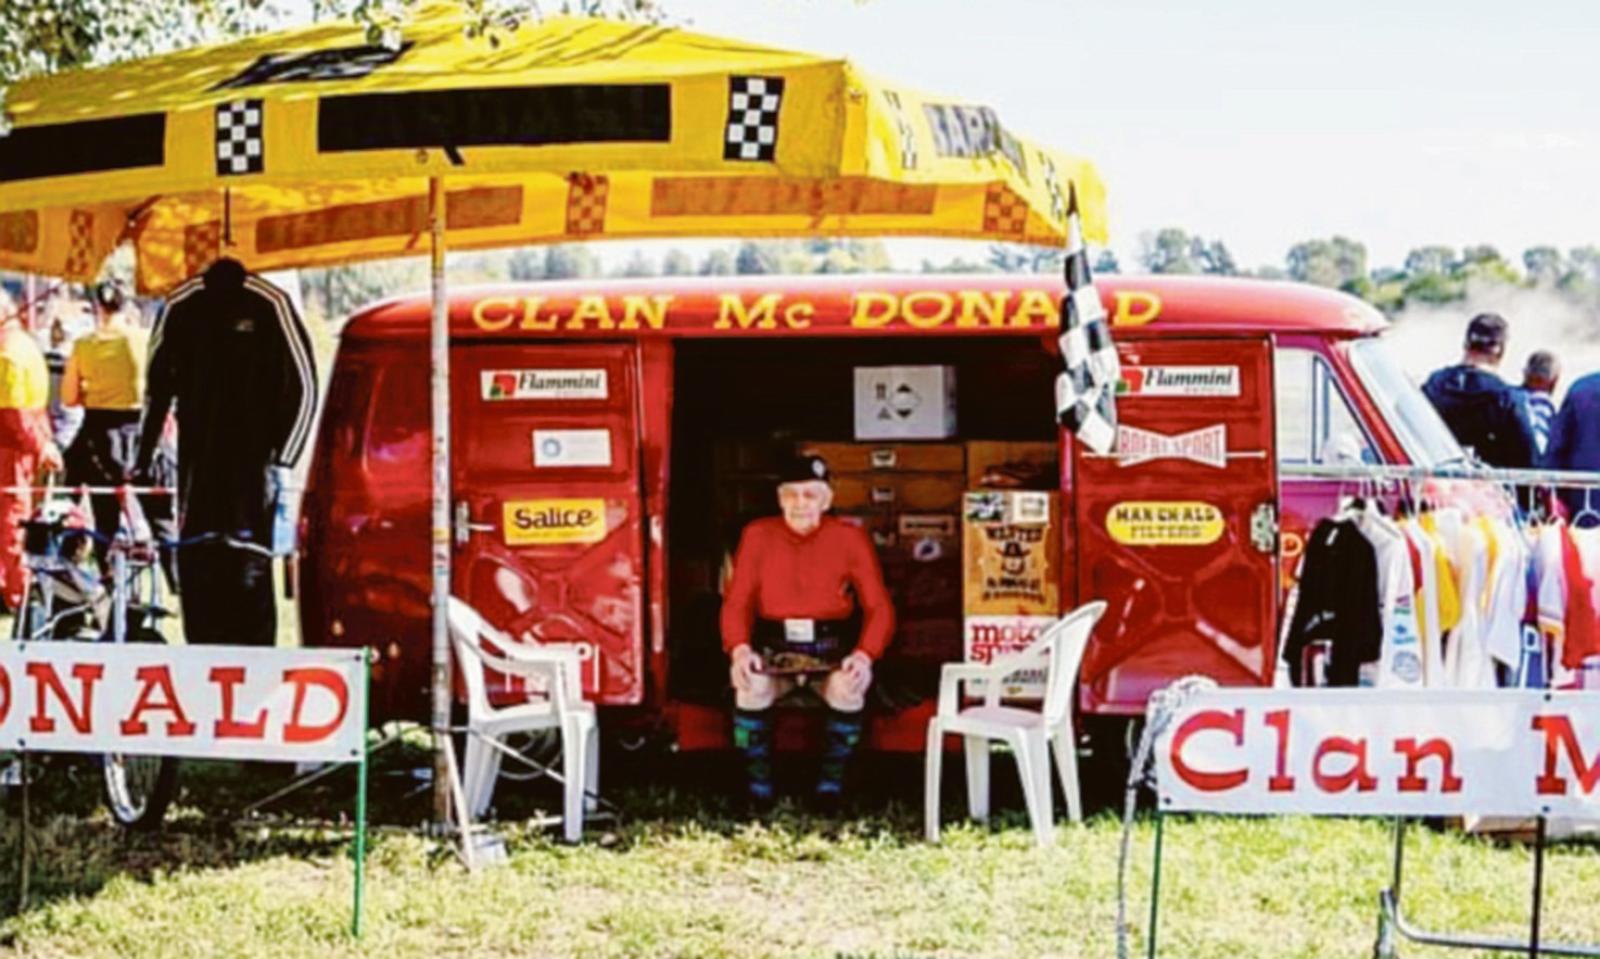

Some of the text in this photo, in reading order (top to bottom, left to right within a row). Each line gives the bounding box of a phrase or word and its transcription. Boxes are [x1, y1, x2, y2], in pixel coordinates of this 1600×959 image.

[472, 289, 1161, 331] CLAN Mc DONAD
[519, 371, 602, 391] Flammini
[1146, 366, 1234, 387] Flammini
[515, 507, 595, 530] Salice
[0, 661, 349, 743] NALD
[1169, 707, 1464, 794] Clan
